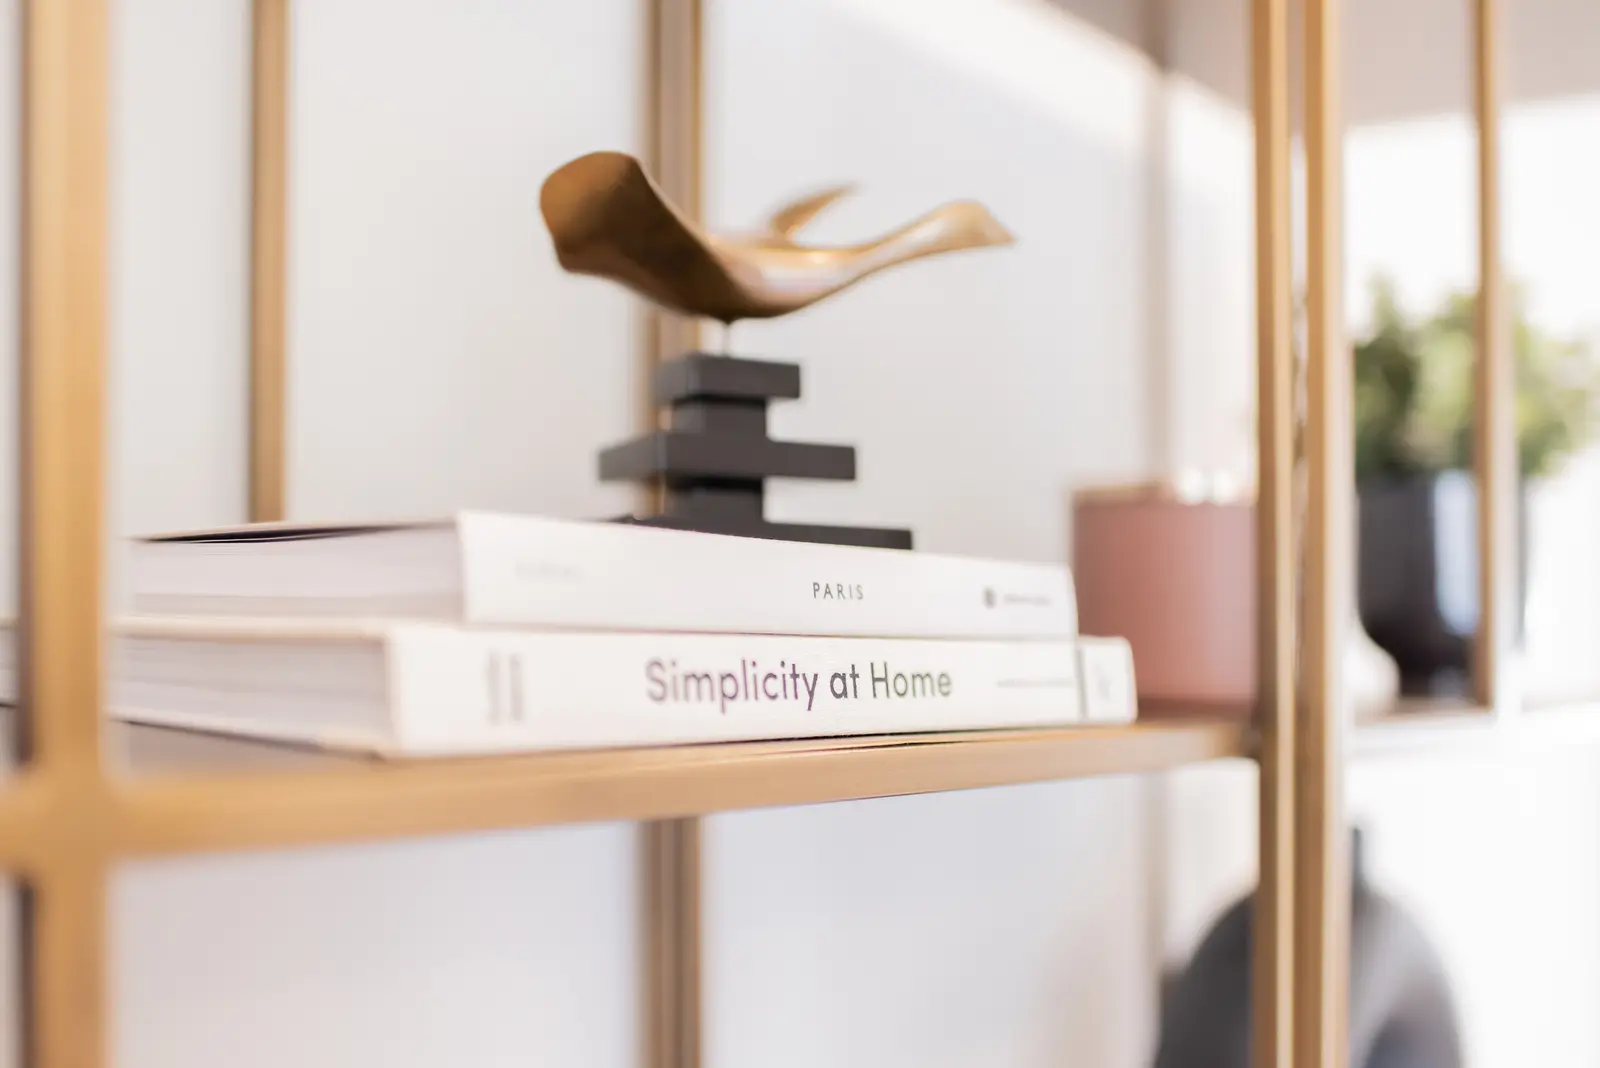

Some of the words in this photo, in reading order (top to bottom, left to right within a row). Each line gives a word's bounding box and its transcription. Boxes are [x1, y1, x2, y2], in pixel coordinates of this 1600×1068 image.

[812, 582, 864, 600] PARIS
[645, 657, 818, 714] Simplicity
[830, 663, 860, 699] at
[870, 661, 952, 699] Home
